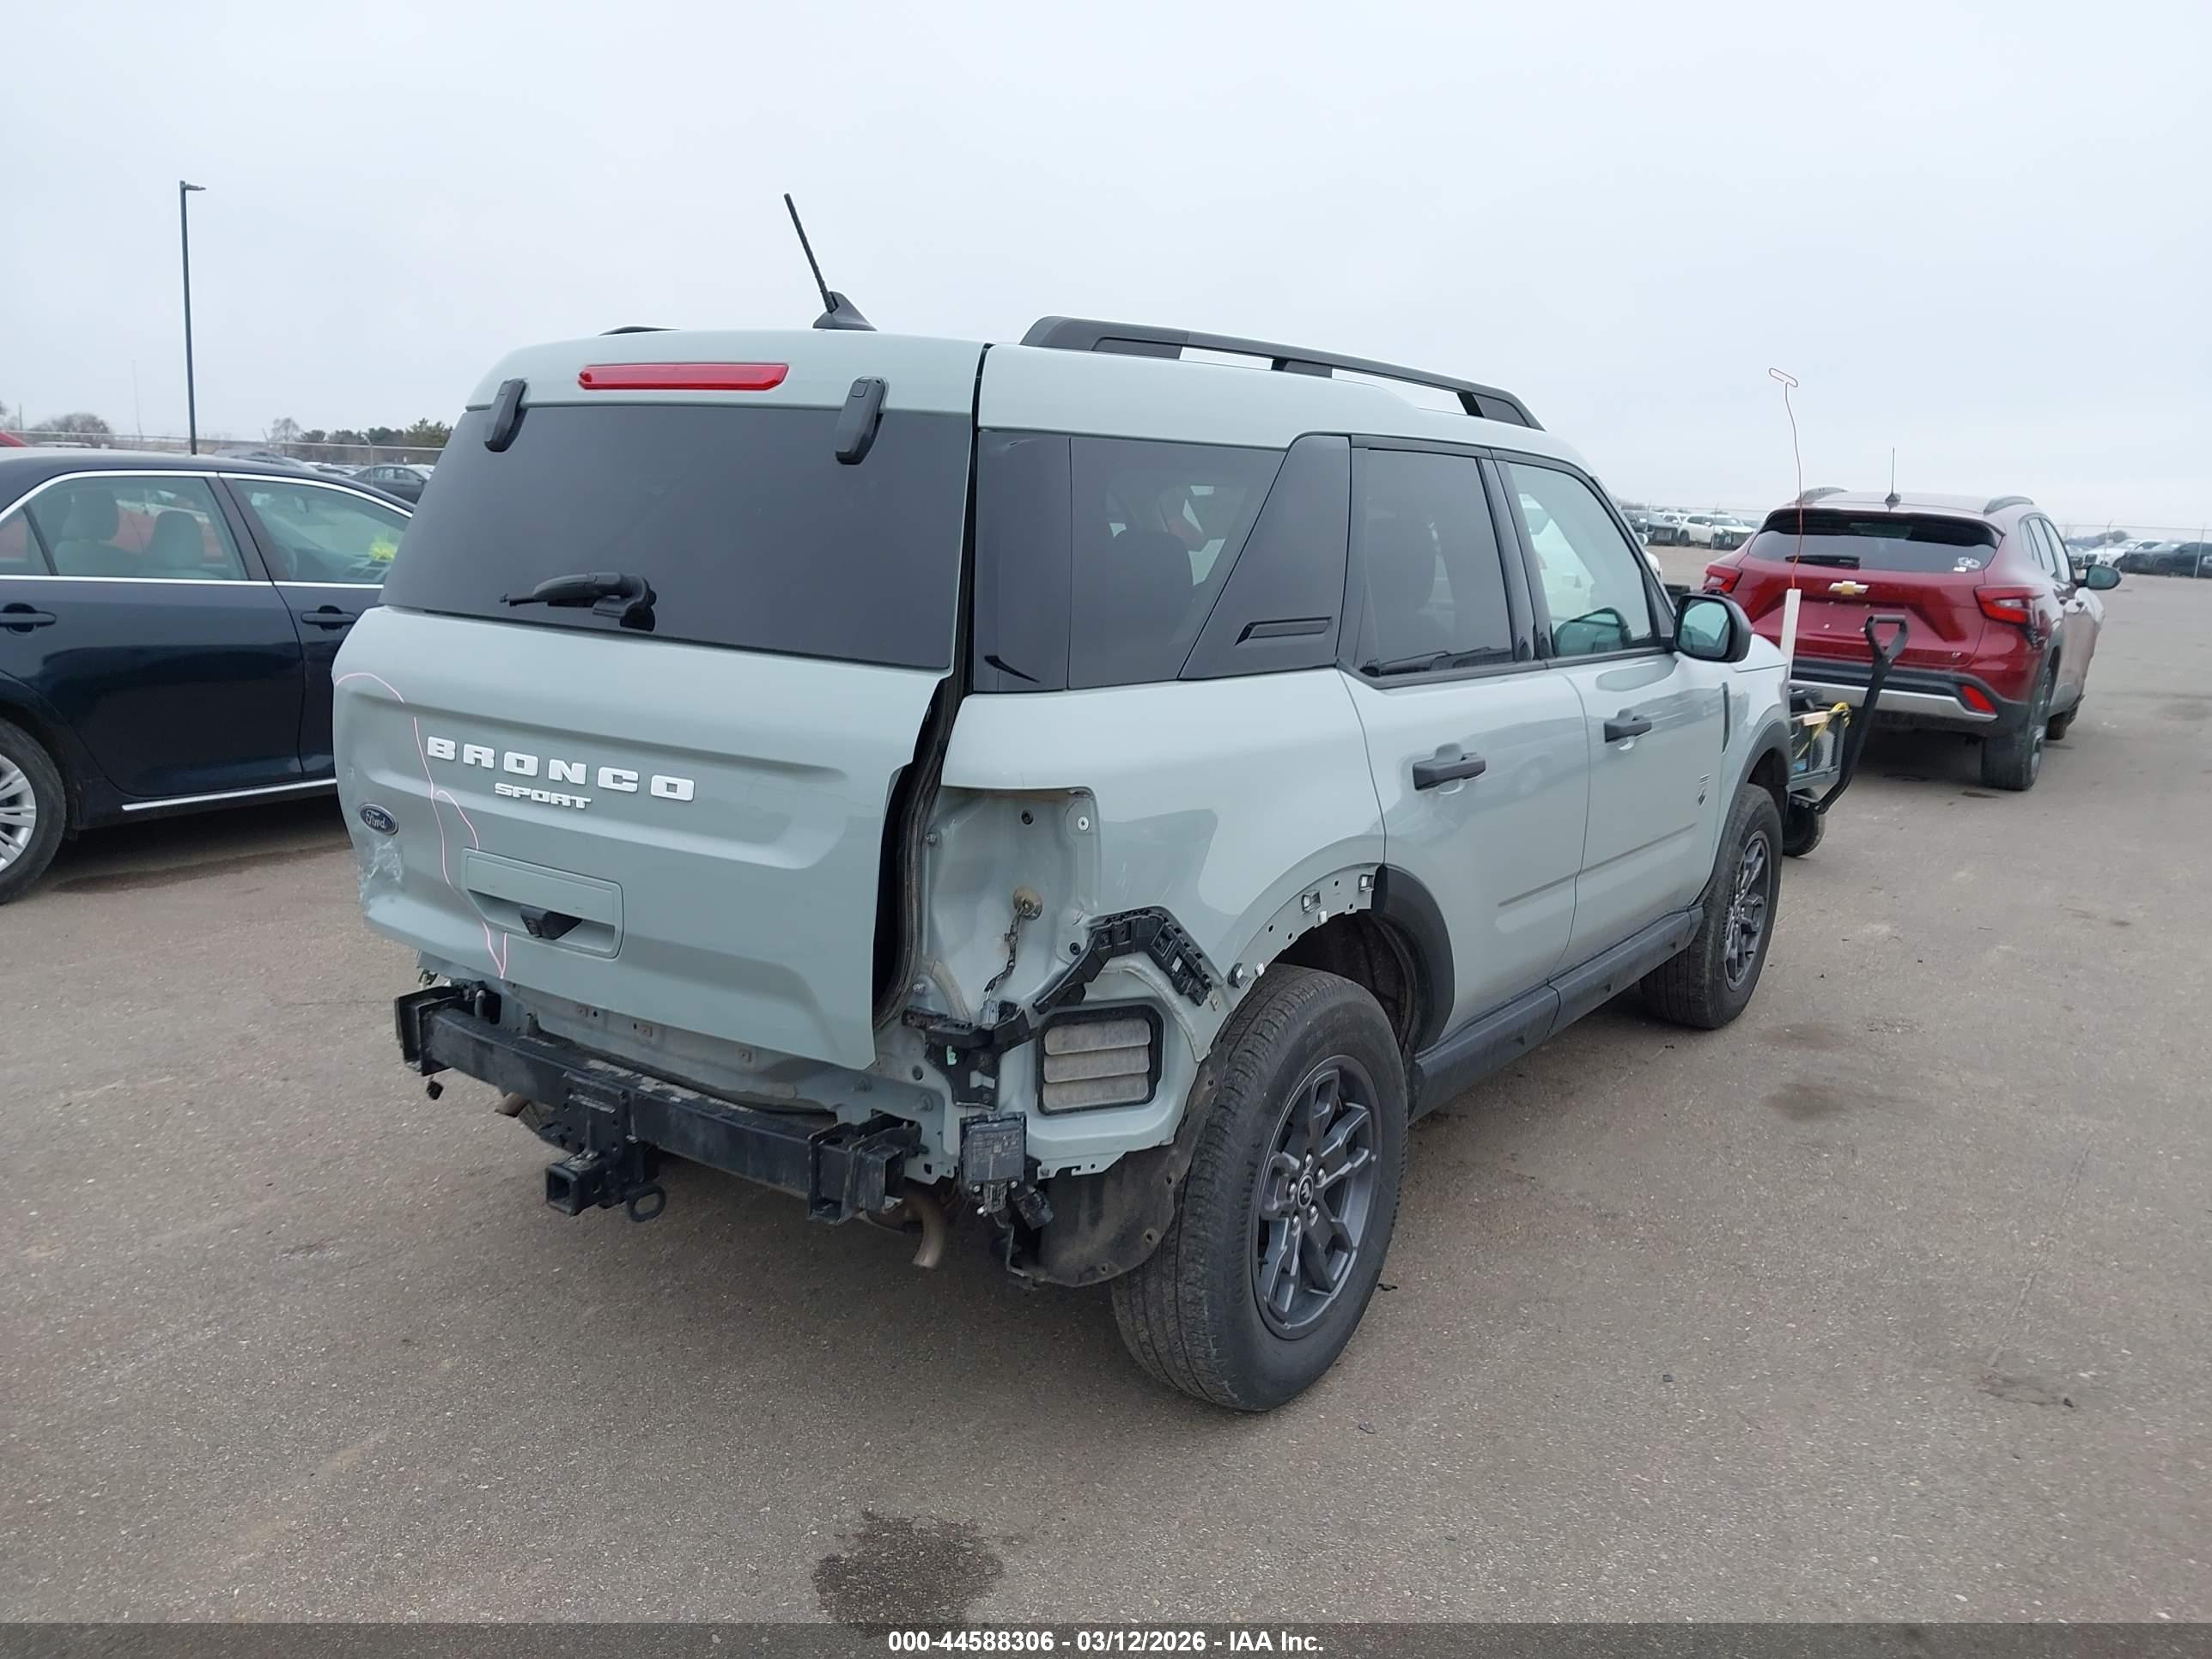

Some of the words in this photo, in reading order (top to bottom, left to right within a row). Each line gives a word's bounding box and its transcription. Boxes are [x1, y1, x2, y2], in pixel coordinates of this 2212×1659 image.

[428, 736, 695, 801] BRONCO
[495, 782, 592, 809] SPORT
[365, 809, 386, 830] Ford
